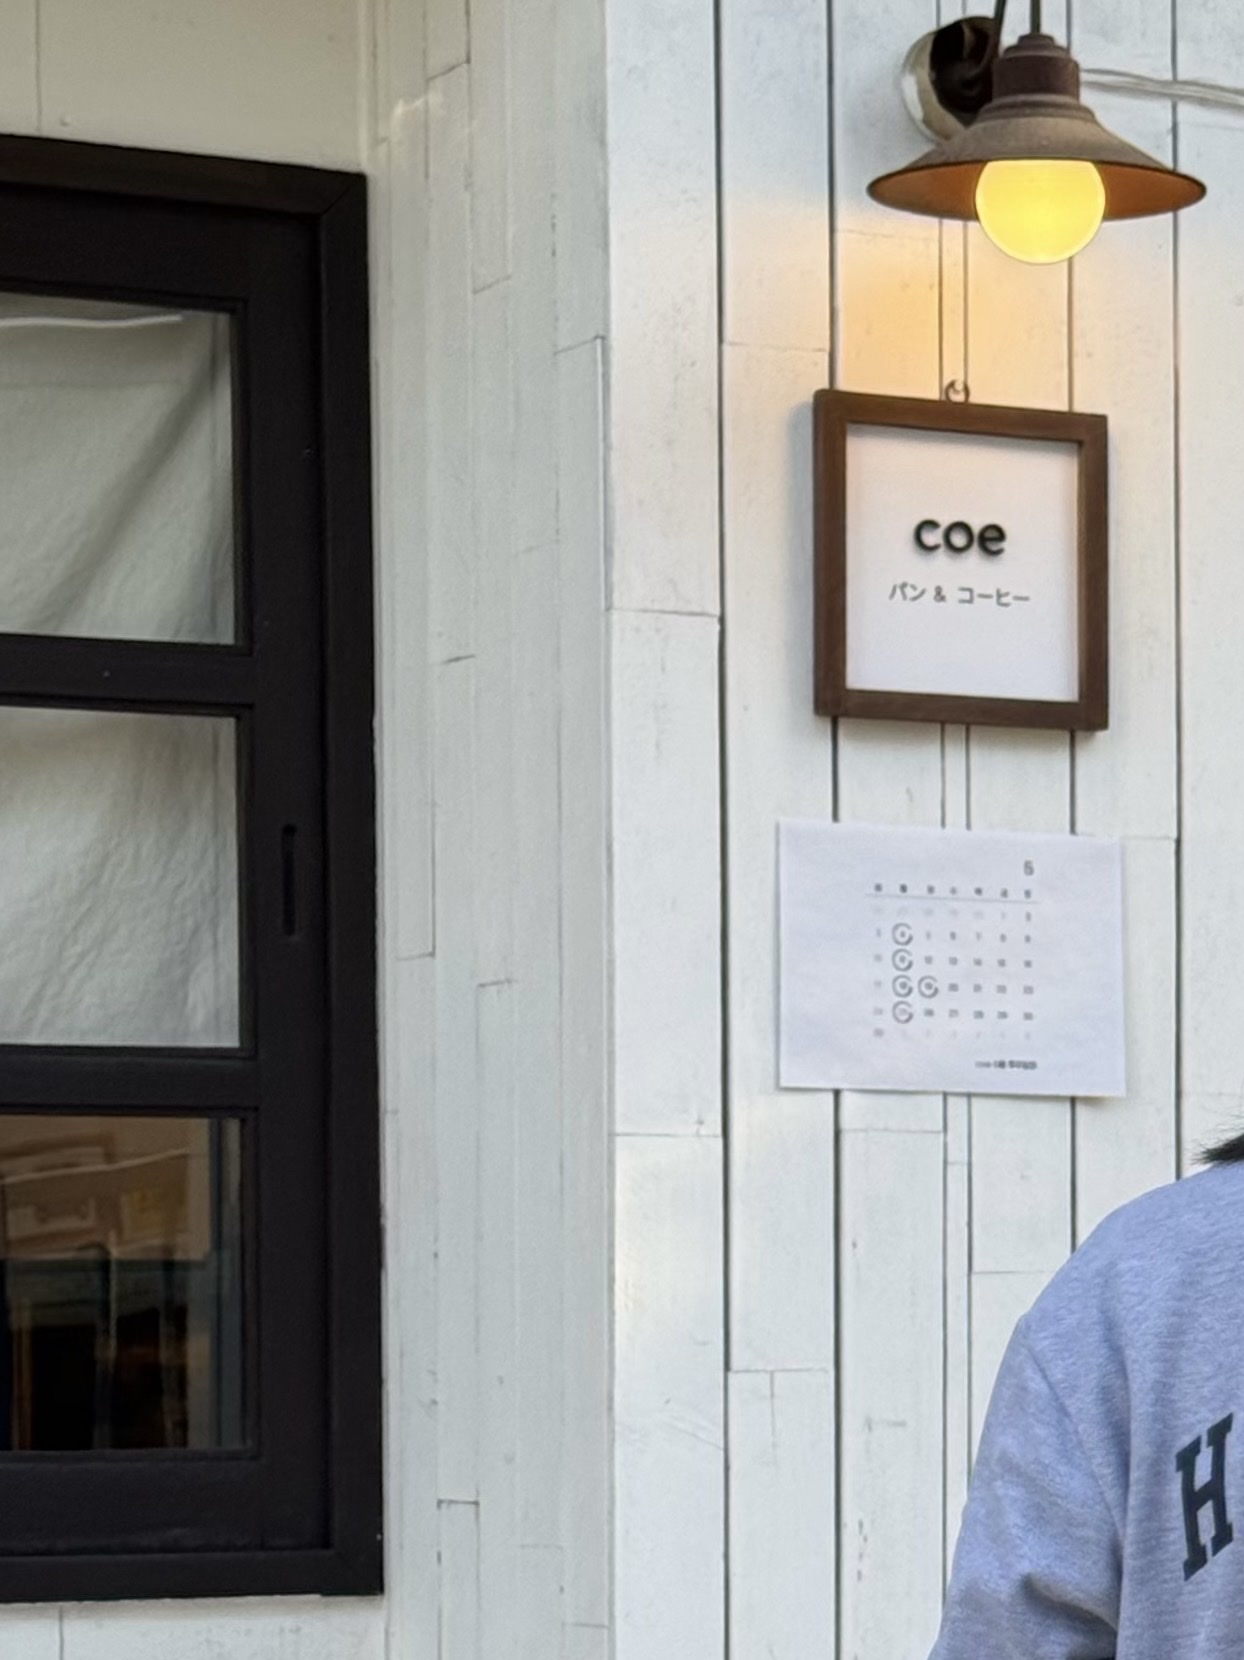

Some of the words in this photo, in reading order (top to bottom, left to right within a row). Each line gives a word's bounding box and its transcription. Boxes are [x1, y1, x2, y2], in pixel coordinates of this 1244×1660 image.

[914, 519, 1007, 556] coe
[889, 581, 927, 601] パン
[933, 585, 947, 603] &
[957, 586, 1031, 608] コーヒー
